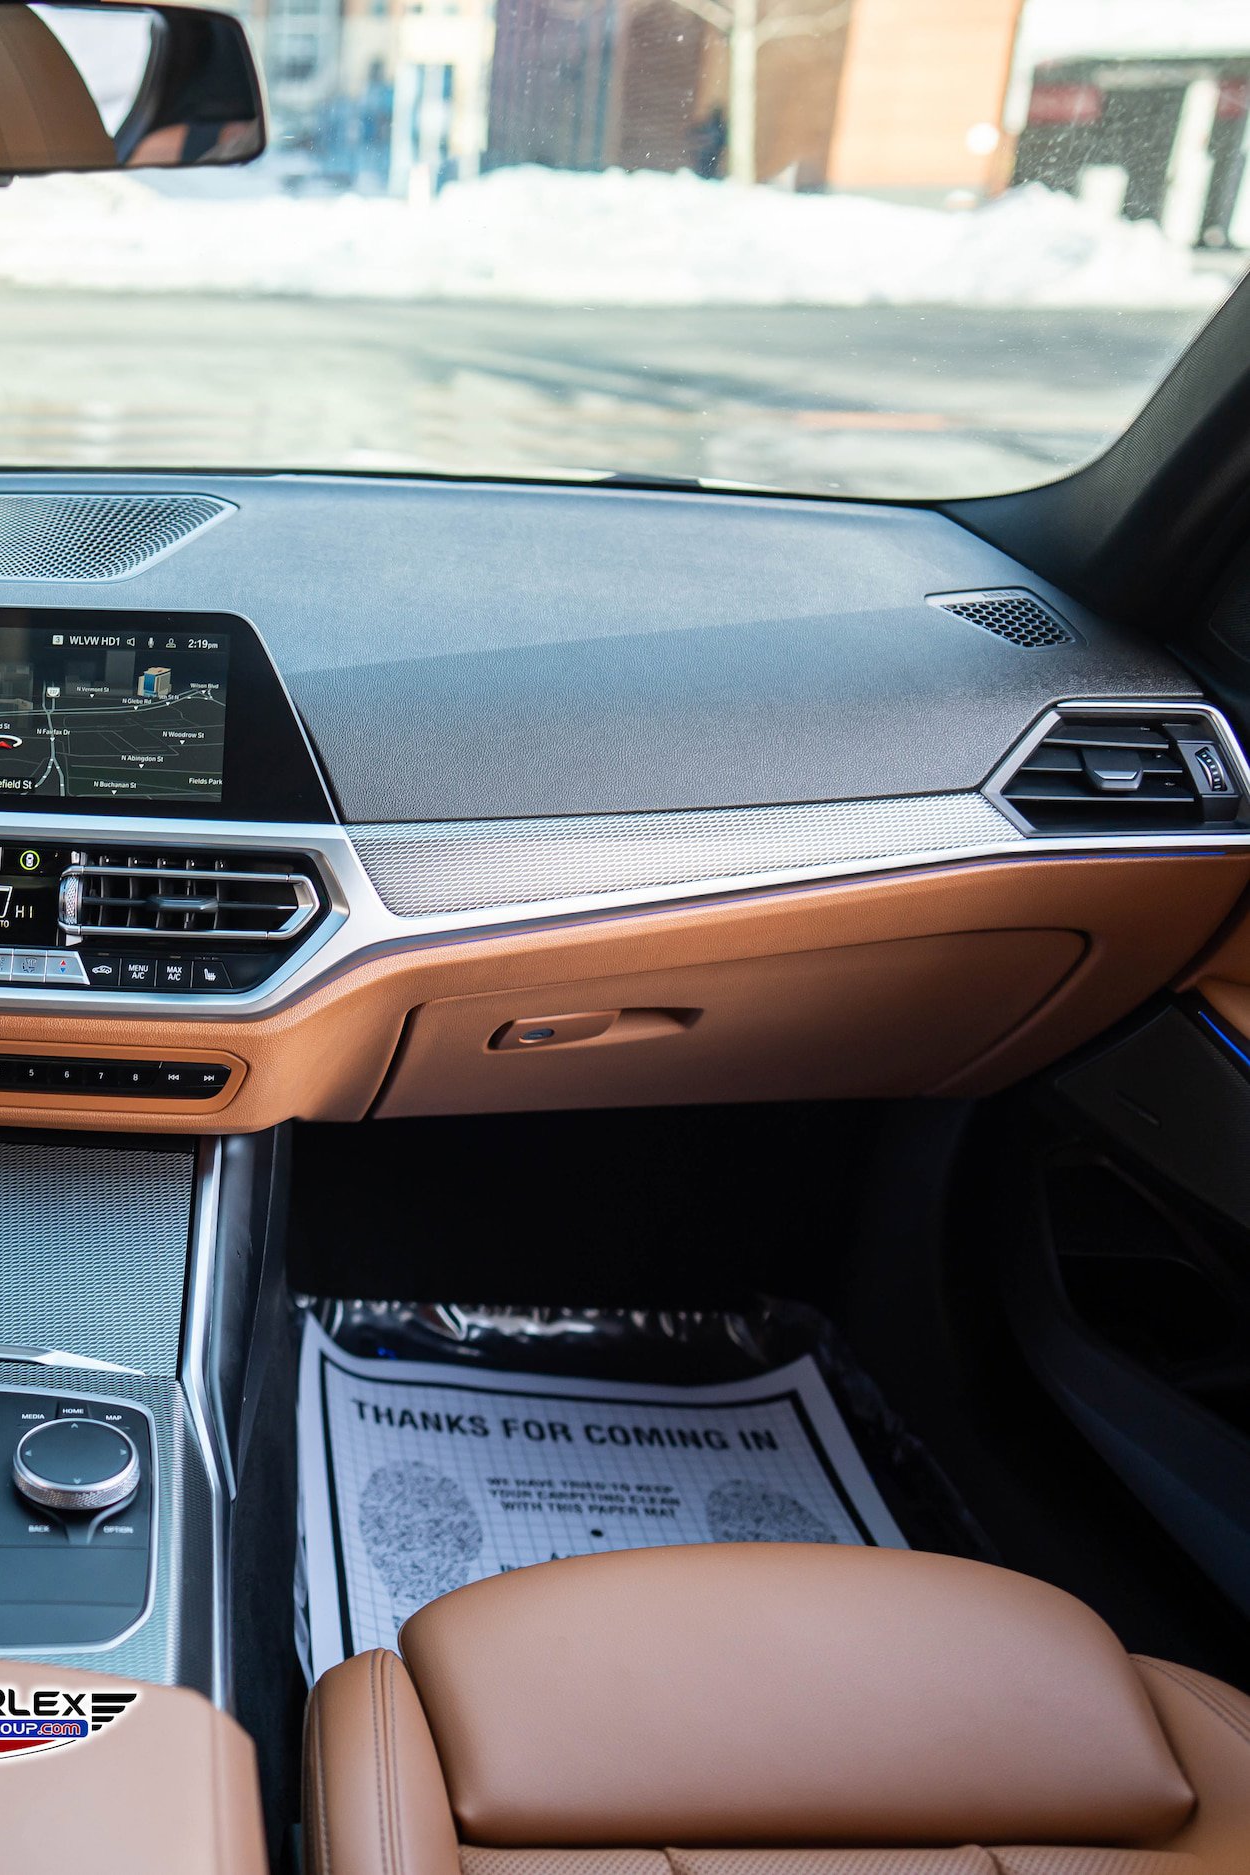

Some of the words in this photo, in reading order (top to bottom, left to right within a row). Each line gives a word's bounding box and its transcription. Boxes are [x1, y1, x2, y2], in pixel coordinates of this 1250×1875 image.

[69, 636, 99, 646] WLVW
[101, 637, 121, 646] HD1
[127, 755, 156, 763] Abingdon
[22, 780, 32, 789] St
[128, 964, 148, 972] MENU
[166, 965, 182, 973] MAX
[132, 971, 145, 979] A/C
[167, 973, 181, 981] A/C
[29, 1068, 34, 1077] 5
[64, 1070, 69, 1078] 6
[133, 1073, 138, 1081] 8
[353, 1400, 491, 1437] THANKS
[502, 1418, 573, 1443] FOR
[585, 1424, 730, 1450] COMING
[738, 1430, 779, 1451] IN
